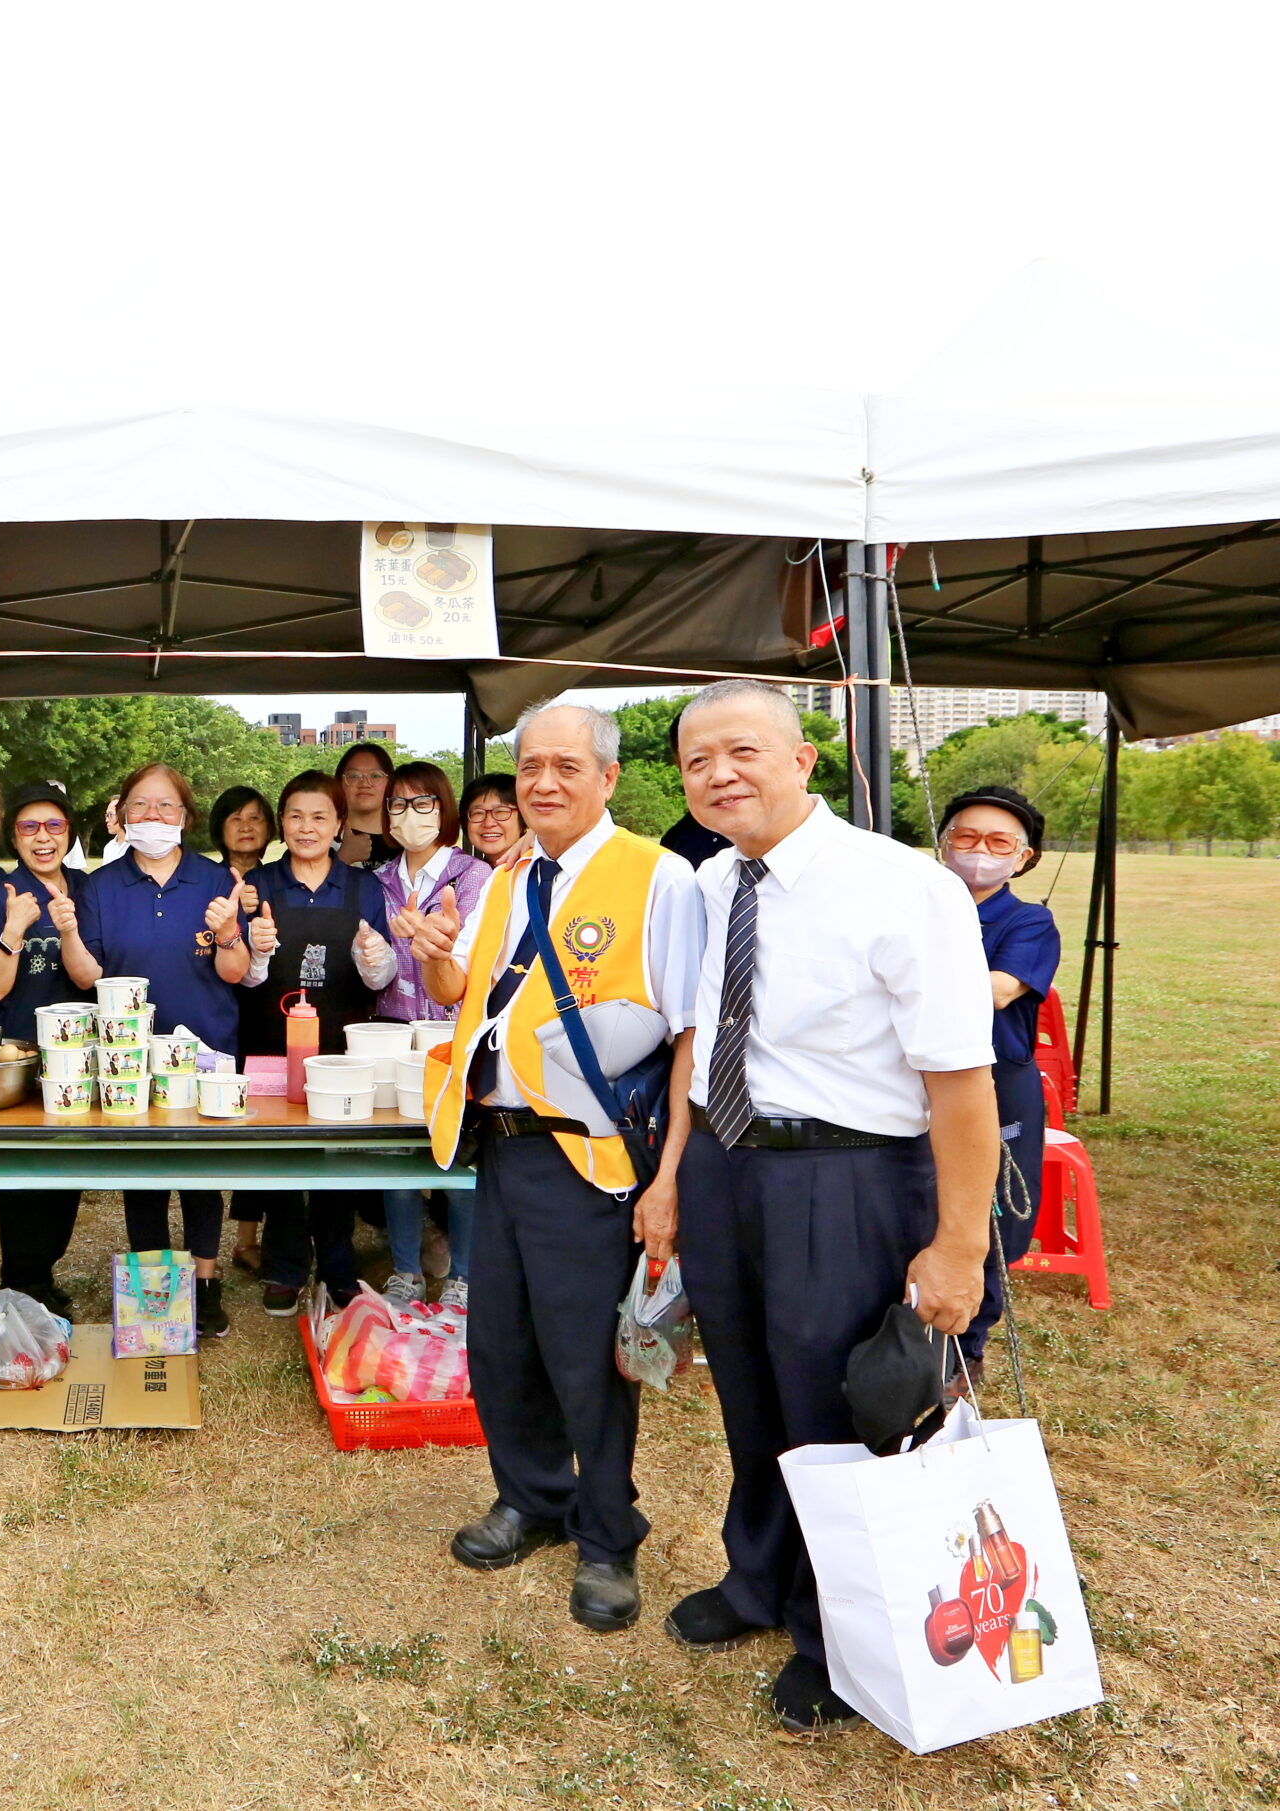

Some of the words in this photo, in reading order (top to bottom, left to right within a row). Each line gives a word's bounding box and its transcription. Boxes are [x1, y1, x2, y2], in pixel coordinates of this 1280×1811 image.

[374, 558, 412, 572] 茶葉蛋
[380, 574, 408, 586] 15元
[433, 596, 476, 610] 冬瓜茶
[442, 611, 472, 623] 20元
[85, 1394, 102, 1421] 114602
[970, 1582, 1005, 1620] 70
[974, 1613, 1012, 1642] years
